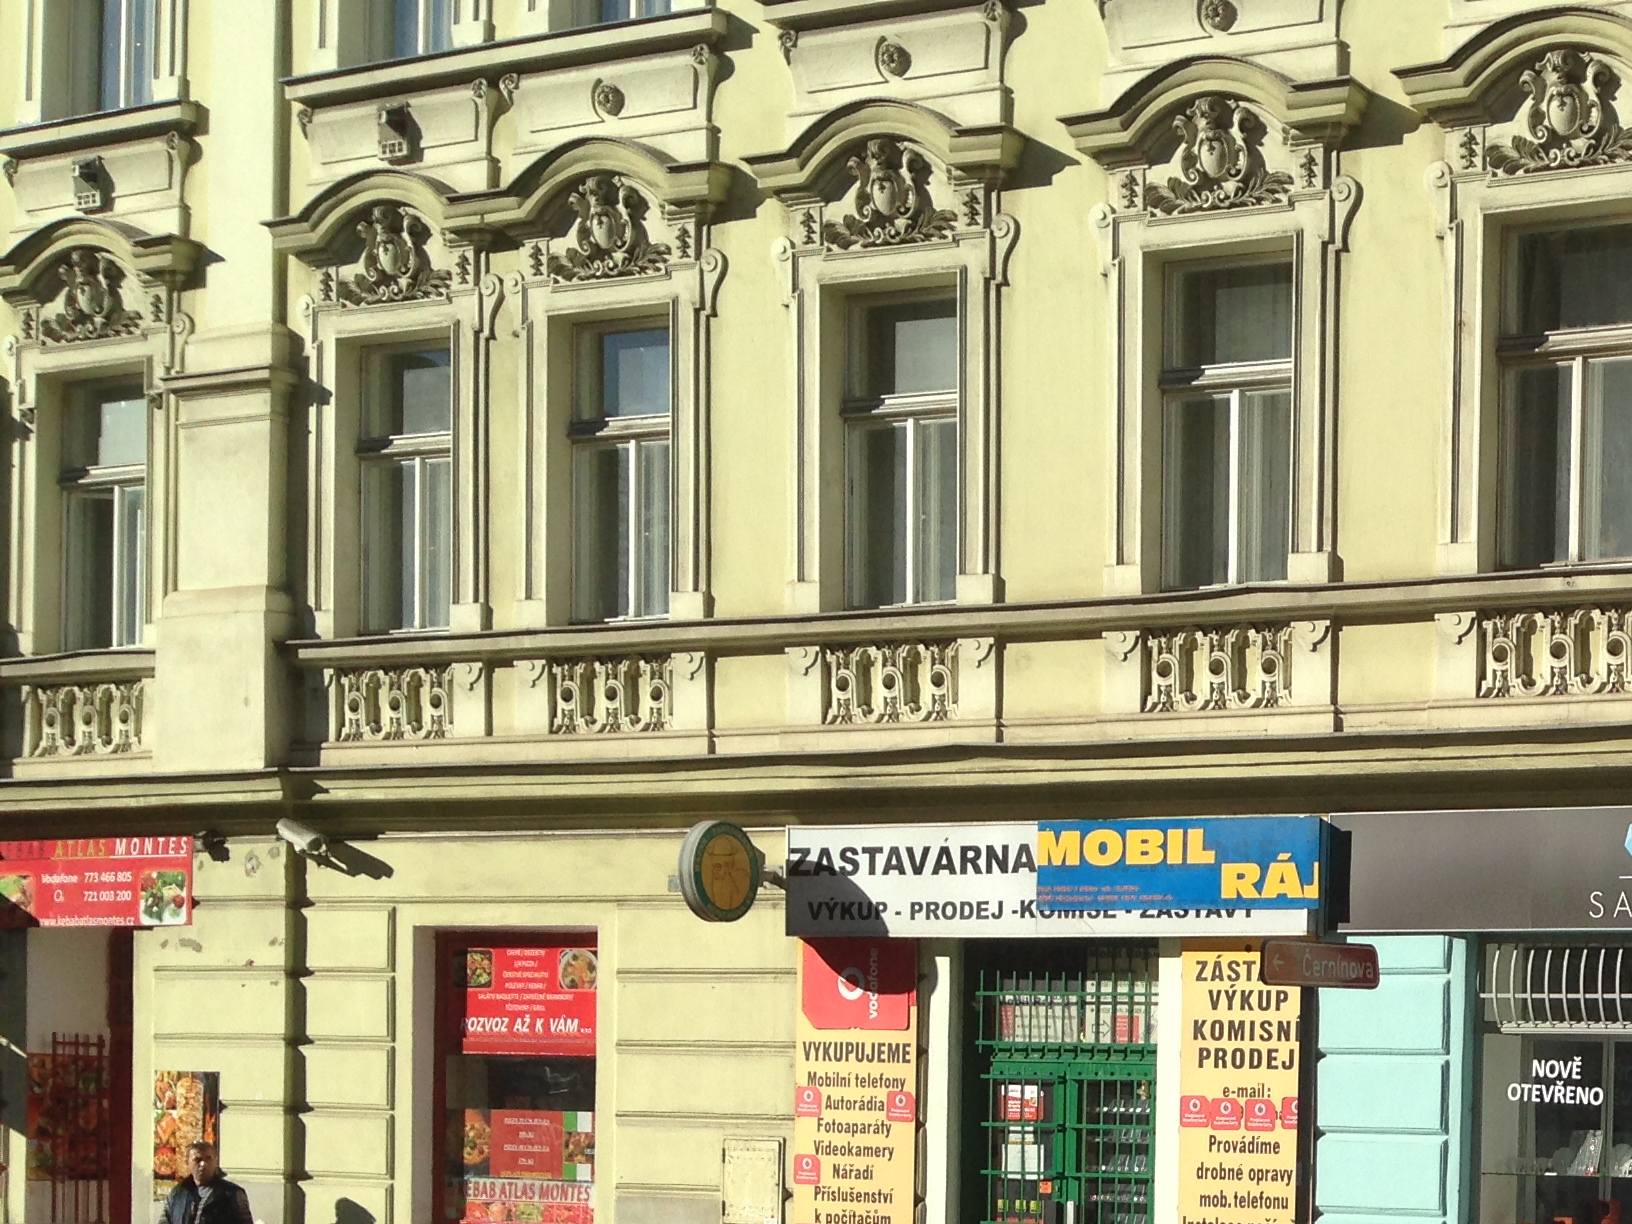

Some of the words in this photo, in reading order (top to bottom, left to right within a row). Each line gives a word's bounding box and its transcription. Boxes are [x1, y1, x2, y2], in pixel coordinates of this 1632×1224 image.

[54, 840, 105, 857] ATLAS
[115, 837, 187, 856] MONTES
[789, 838, 1037, 877] ZASTAVÁRNA
[1037, 828, 1216, 866] MOBIL
[1220, 852, 1319, 899] RÁJ
[808, 897, 888, 921] VÝKUP
[909, 900, 1003, 920] PRODEJ
[1302, 946, 1374, 979] Černínova
[867, 947, 879, 1019] vodafone
[1207, 984, 1289, 1012] VÝKUP
[460, 1016, 510, 1033] ROZVOZ
[513, 1013, 530, 1033] AŽ
[535, 1016, 545, 1033] K
[549, 1013, 579, 1033] VÁM
[1193, 1015, 1300, 1042] KOMISNÍ
[802, 1041, 911, 1064] VYKUPUJEME
[1197, 1047, 1295, 1071] PRODEJ
[1532, 1056, 1582, 1080] NOVĚ
[807, 1070, 851, 1088] Mobilní
[855, 1072, 906, 1092] telefony
[824, 1094, 885, 1112] Autorádia
[1507, 1080, 1604, 1106] OTEVŘENO
[816, 1116, 892, 1138] Fotoaparáty
[813, 1140, 895, 1162] Videokamery
[1208, 1134, 1281, 1155] Provádíme
[832, 1162, 873, 1181] Nářadí
[1196, 1161, 1244, 1182] drobné
[1248, 1167, 1294, 1187] opravy
[499, 1181, 535, 1200] ATLAS
[539, 1182, 590, 1202] MONTES
[814, 1186, 894, 1205] Příslušenství
[814, 1208, 822, 1224] k
